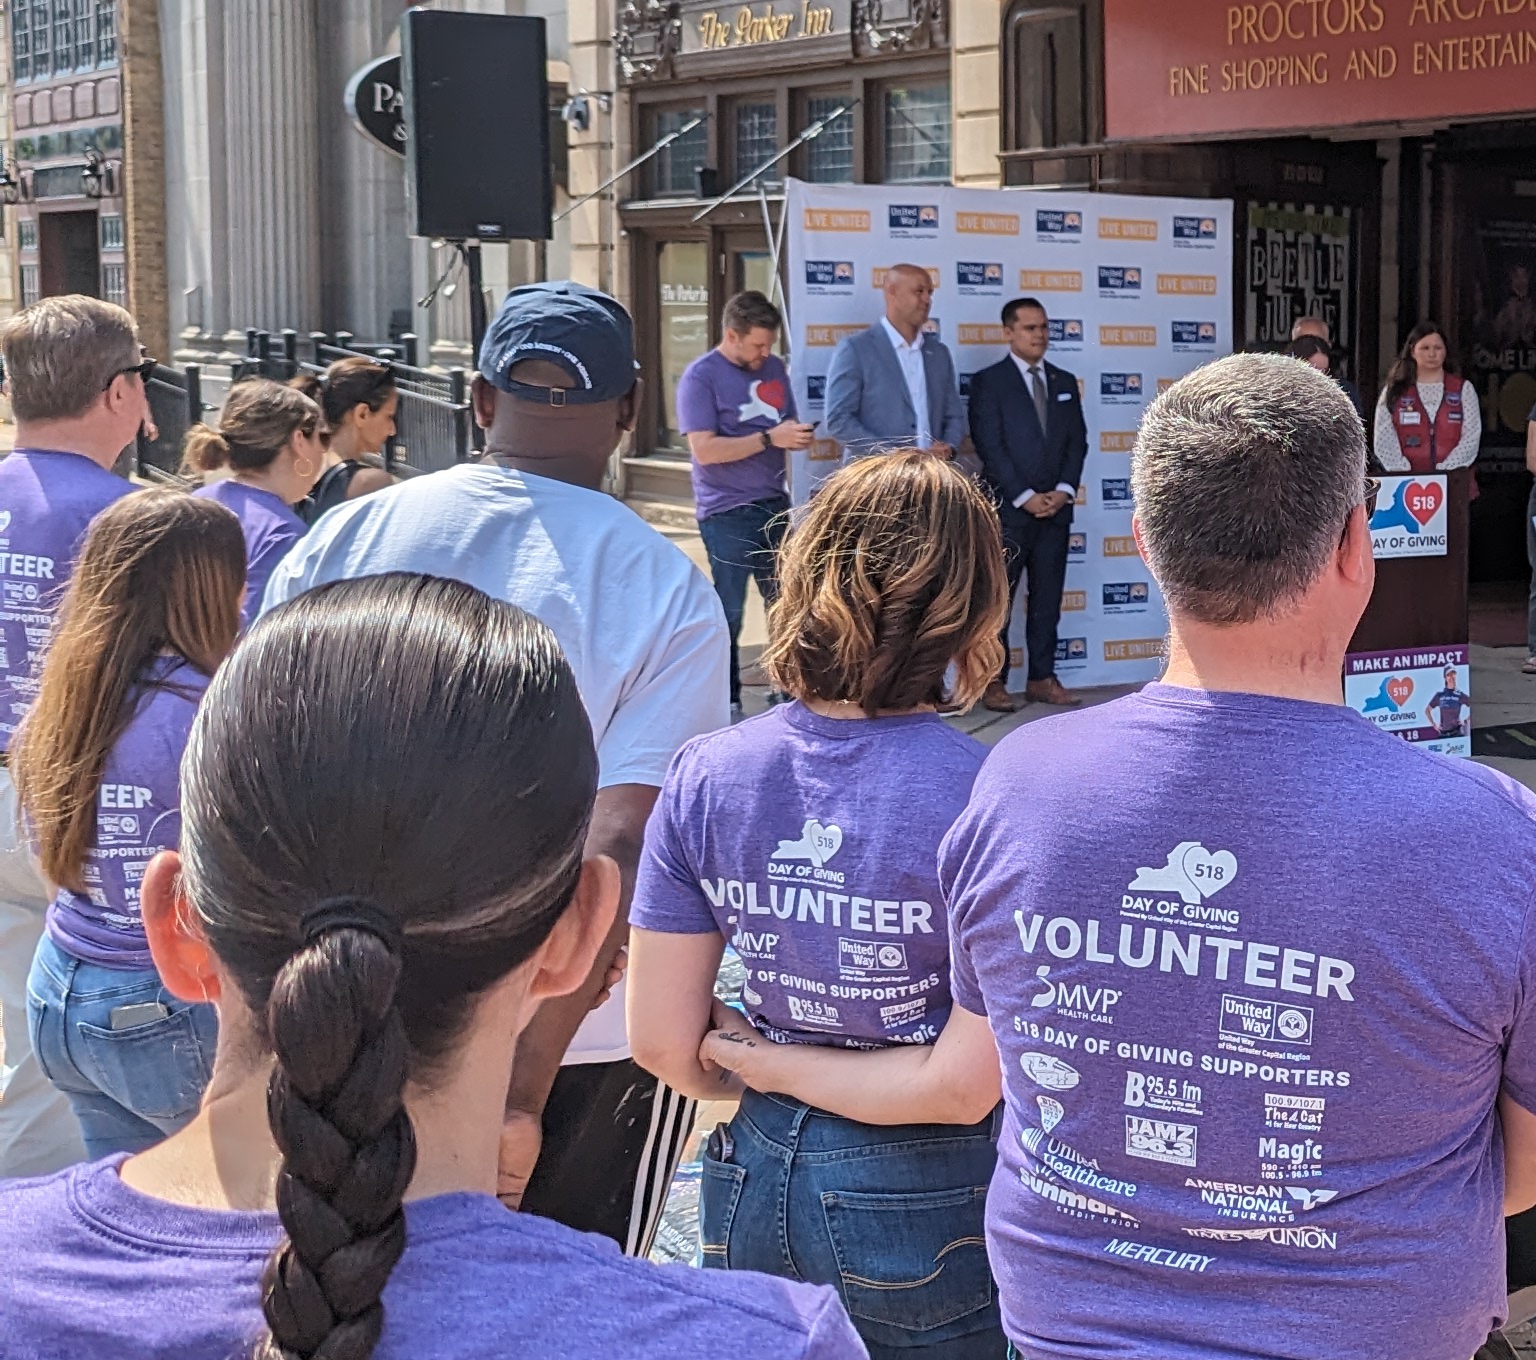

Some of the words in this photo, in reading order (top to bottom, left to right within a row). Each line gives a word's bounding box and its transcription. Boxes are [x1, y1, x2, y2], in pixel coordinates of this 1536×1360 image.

[700, 10, 730, 48] The
[735, 4, 794, 44] Parker
[1170, 63, 1209, 96] FINE
[1222, 52, 1328, 93] SHOPPING
[1345, 46, 1396, 81] AND
[806, 213, 827, 227] LIVE
[831, 213, 868, 228] UNITED
[891, 207, 917, 217] United
[901, 217, 917, 227] Way
[1253, 240, 1345, 288] BEETLE
[1412, 495, 1435, 511] 518
[1390, 536, 1405, 549] OF
[1407, 535, 1446, 547] GIVING
[1353, 658, 1390, 672] MAKE
[1393, 655, 1411, 668] AN
[1414, 651, 1463, 667] IMPACT
[1393, 685, 1408, 697] 518
[1390, 712, 1416, 722] GIVING
[817, 835, 834, 850] 518
[768, 862, 794, 877] DAY
[796, 865, 812, 878] OF
[814, 867, 845, 883] GIVING
[1194, 862, 1224, 881] 518
[700, 877, 935, 935] VOLUNTEER
[1122, 895, 1153, 911] DAY
[1157, 901, 1179, 915] OF
[1183, 905, 1239, 924] GIVING
[841, 941, 875, 956] United
[1014, 910, 1356, 1002] VOLUNTEER
[853, 954, 875, 969] Way
[757, 970, 777, 983] OF
[780, 973, 826, 995] GIVING
[829, 972, 940, 1001] SUPPORTERS
[1056, 984, 1119, 1014] MVP
[1225, 999, 1272, 1020] United
[1057, 1007, 1088, 1021] HEALTH
[1242, 1017, 1271, 1038] Way
[1013, 1015, 1040, 1039] 518
[1043, 1028, 1079, 1049] DAY
[1084, 1037, 1110, 1056] OF
[1117, 1041, 1194, 1068] GIVING
[1200, 1054, 1350, 1087] SUPPORTERS
[1265, 1107, 1288, 1122] The
[1301, 1110, 1323, 1124] Cat
[1129, 1117, 1194, 1144] JAMZ
[1258, 1137, 1323, 1165] Magic
[1184, 1177, 1283, 1199] AMERICAN
[1201, 1188, 1293, 1214] NATIONAL
[1218, 1207, 1294, 1223] INSURANCE
[1269, 1227, 1338, 1250] UNION
[1104, 1238, 1216, 1274] MERCURY
